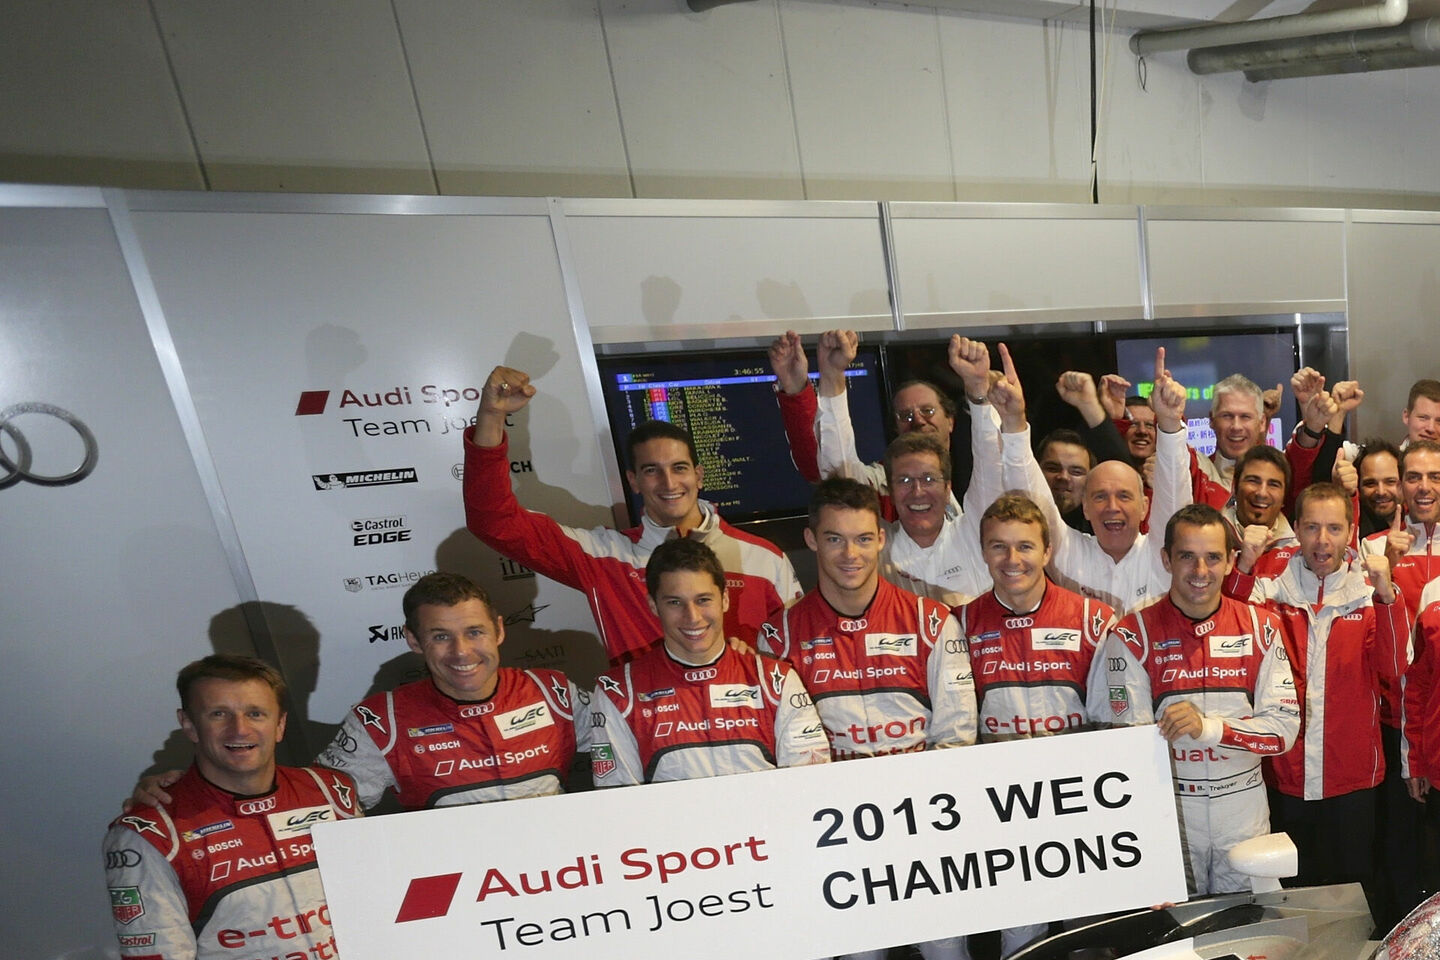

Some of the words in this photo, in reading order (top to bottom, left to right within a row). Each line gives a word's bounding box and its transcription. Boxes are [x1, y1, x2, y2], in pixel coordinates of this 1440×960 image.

[339, 386, 412, 408] Audi
[343, 417, 431, 438] Team
[345, 470, 415, 484] MICHELIN
[364, 517, 404, 531] Castrol
[354, 529, 411, 546] EDGE
[879, 637, 914, 647] WEC
[1045, 632, 1078, 642] WEC
[832, 669, 863, 680] Audi
[867, 666, 907, 678] Sport
[999, 660, 1031, 672] Audi
[1034, 660, 1071, 673] Sport
[1178, 667, 1209, 679] Audi
[1212, 666, 1247, 678] Sport
[510, 706, 545, 726] WEC
[676, 719, 711, 732] Audi
[715, 717, 758, 731] Sport
[985, 712, 1083, 736] e-tron
[428, 740, 461, 752] BOSCH
[458, 752, 501, 772] Audi
[505, 743, 550, 765] Sport
[287, 809, 331, 827] WEC
[812, 793, 962, 848] 2013
[985, 771, 1132, 823] WEC
[206, 838, 243, 854] BOSCH
[236, 851, 287, 871] Audi
[475, 855, 602, 903] Audi
[620, 836, 769, 884] Sport
[822, 831, 1142, 911] CHAMPIONS
[481, 906, 631, 951] Team
[649, 883, 774, 932] Joest
